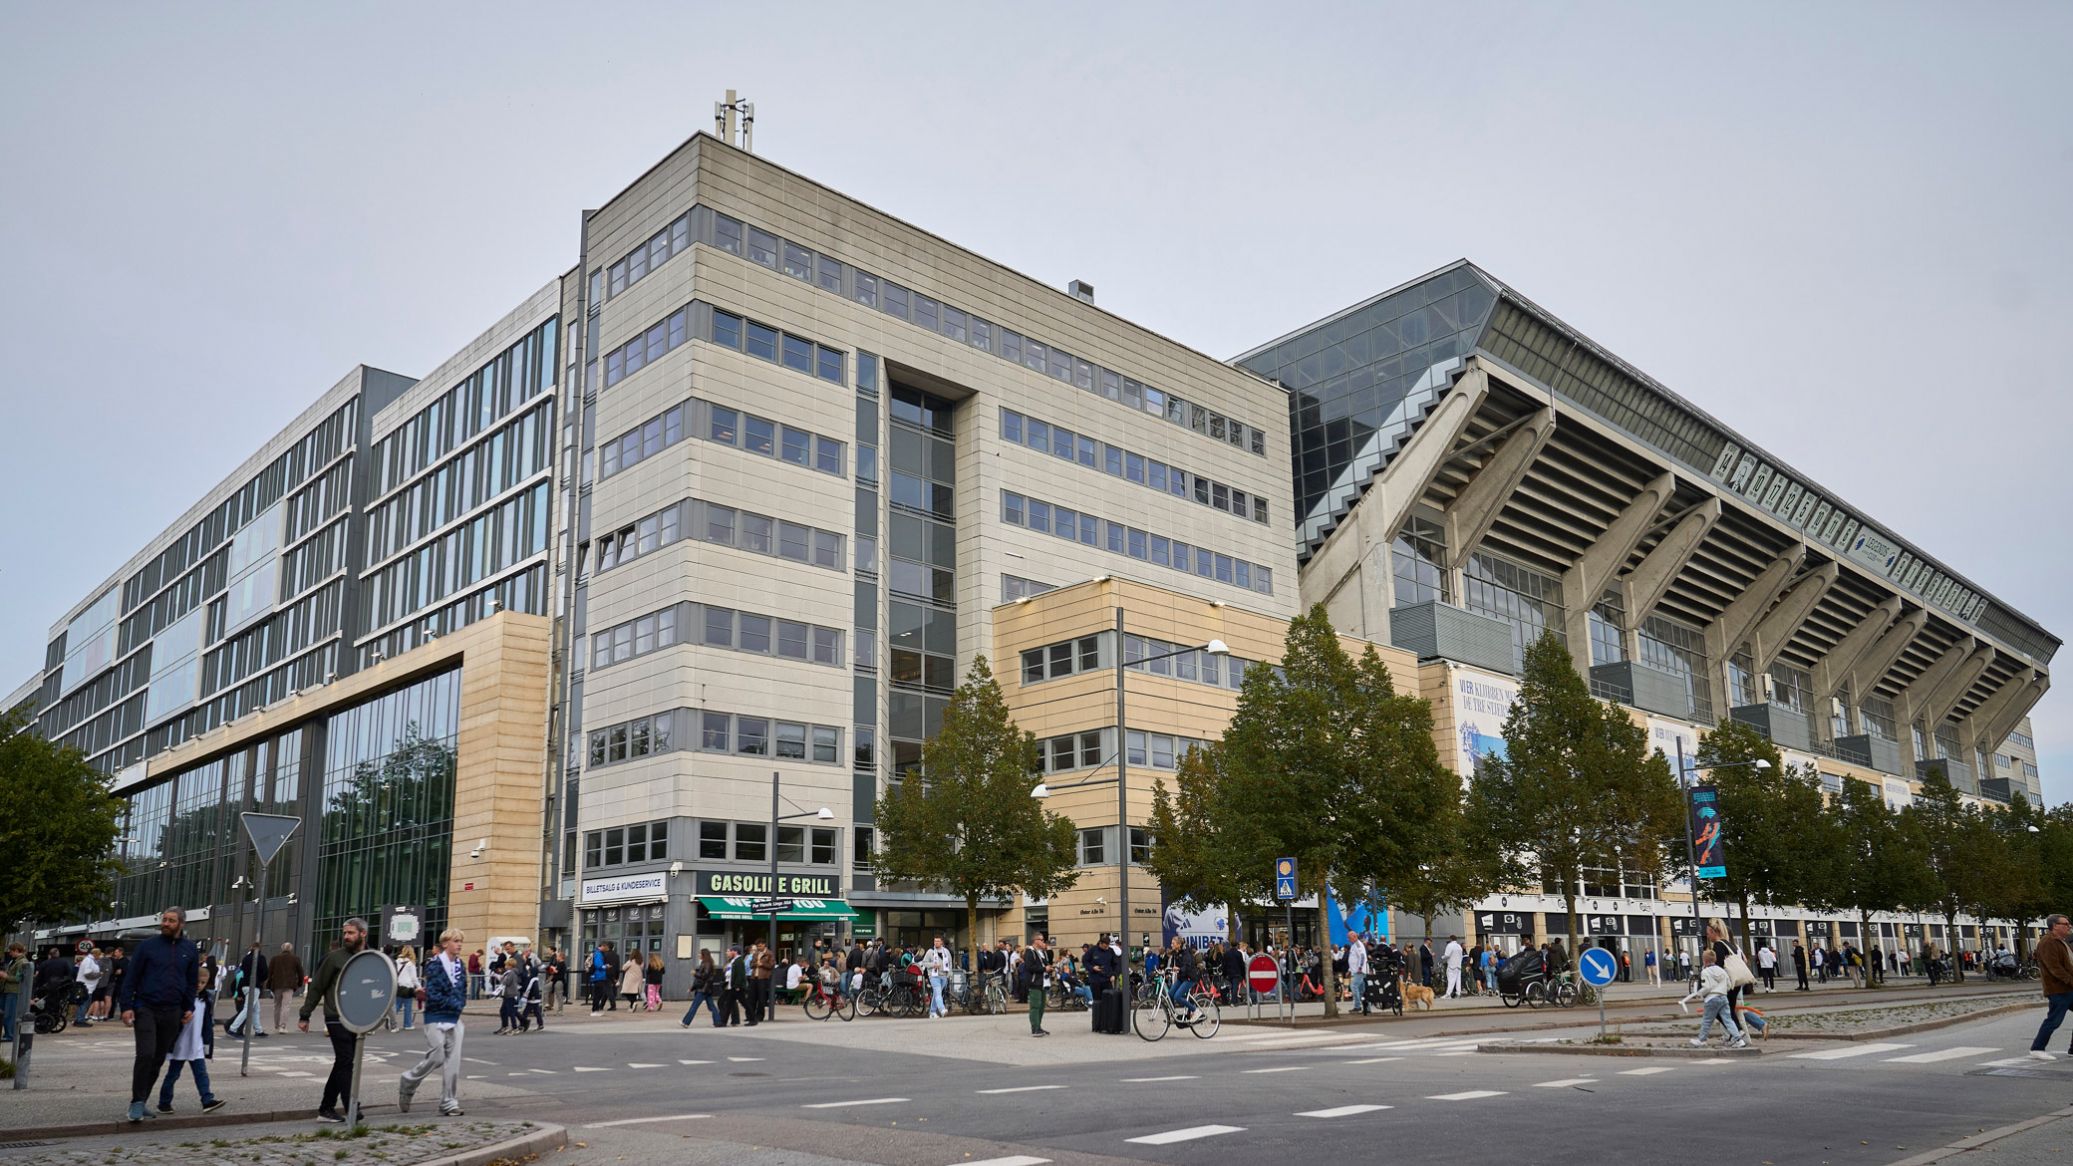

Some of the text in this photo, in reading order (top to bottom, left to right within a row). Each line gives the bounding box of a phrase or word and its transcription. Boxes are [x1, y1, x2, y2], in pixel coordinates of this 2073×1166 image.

[1718, 453, 1733, 473] 14
[1752, 473, 1765, 492] 10
[1768, 483, 1782, 502] 17
[1783, 492, 1796, 510] 12
[1799, 501, 1810, 518] 5
[1865, 536, 1890, 558] LEGENDS
[586, 883, 615, 894] BILLETSALG
[621, 878, 661, 890] KUNDESERVICE
[791, 877, 832, 895] GRILL
[80, 942, 91, 950] 20
